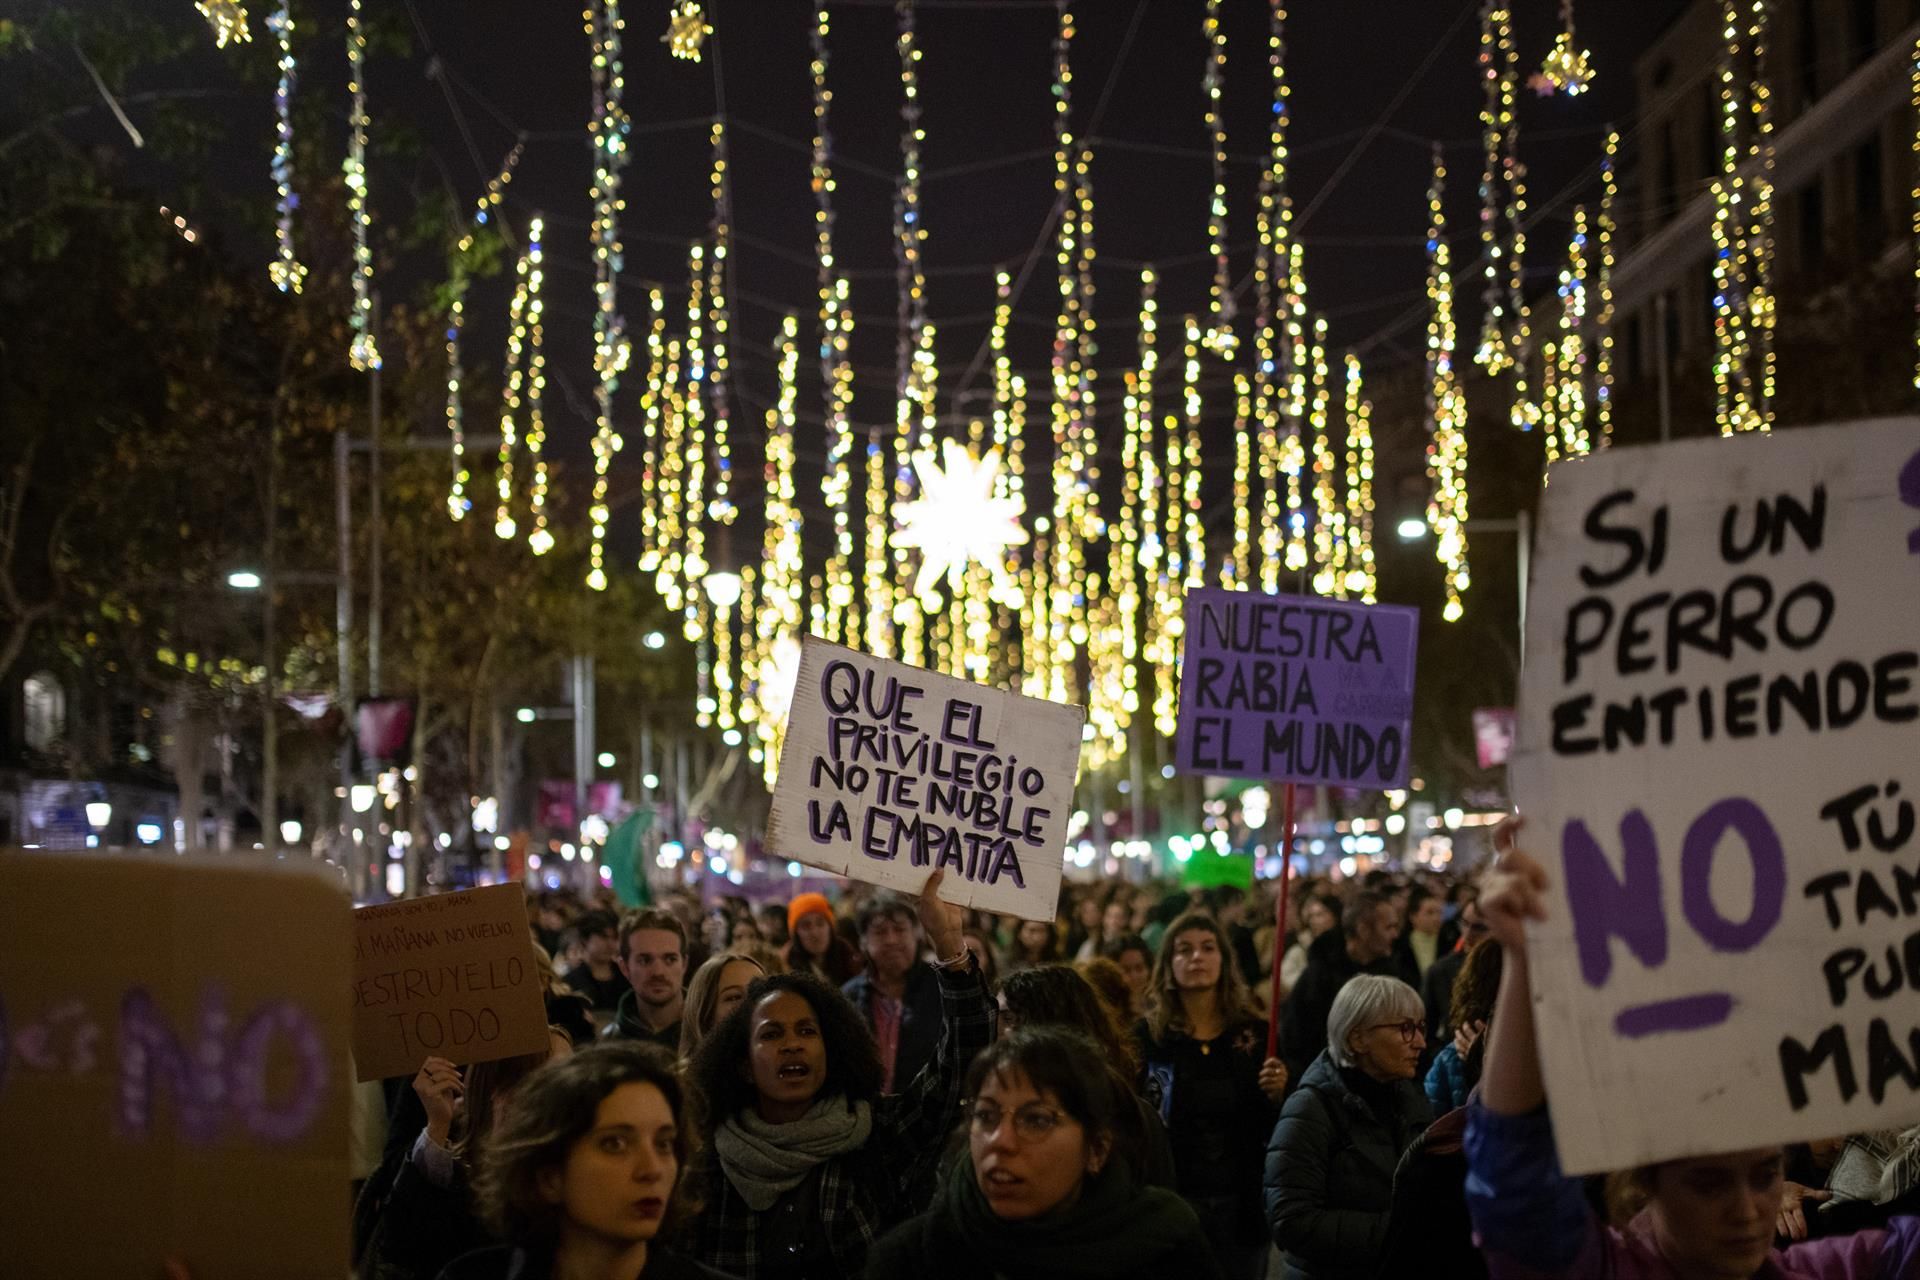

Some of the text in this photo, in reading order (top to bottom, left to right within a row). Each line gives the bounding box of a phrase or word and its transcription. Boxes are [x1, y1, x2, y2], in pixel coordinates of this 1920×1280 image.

[1578, 479, 1827, 588] SI UN
[1201, 602, 1383, 663] NUESTRA
[1563, 574, 1835, 685] PERRO
[821, 660, 995, 750] QUE EL
[1195, 657, 1318, 715] RABIA
[1552, 651, 1920, 756] ENTIENDE
[1191, 717, 1401, 782] EL MUNDO
[808, 800, 1026, 888] LA EMPATÍA
[810, 756, 1050, 846] NO TE NUBLE
[1818, 779, 1915, 852] TÚ
[1561, 795, 1787, 988] NO
[370, 926, 440, 957] MAÑANA
[445, 927, 464, 944] NO
[115, 976, 328, 1145] NO
[388, 1007, 500, 1057] TODO
[1779, 1016, 1920, 1111] MA
